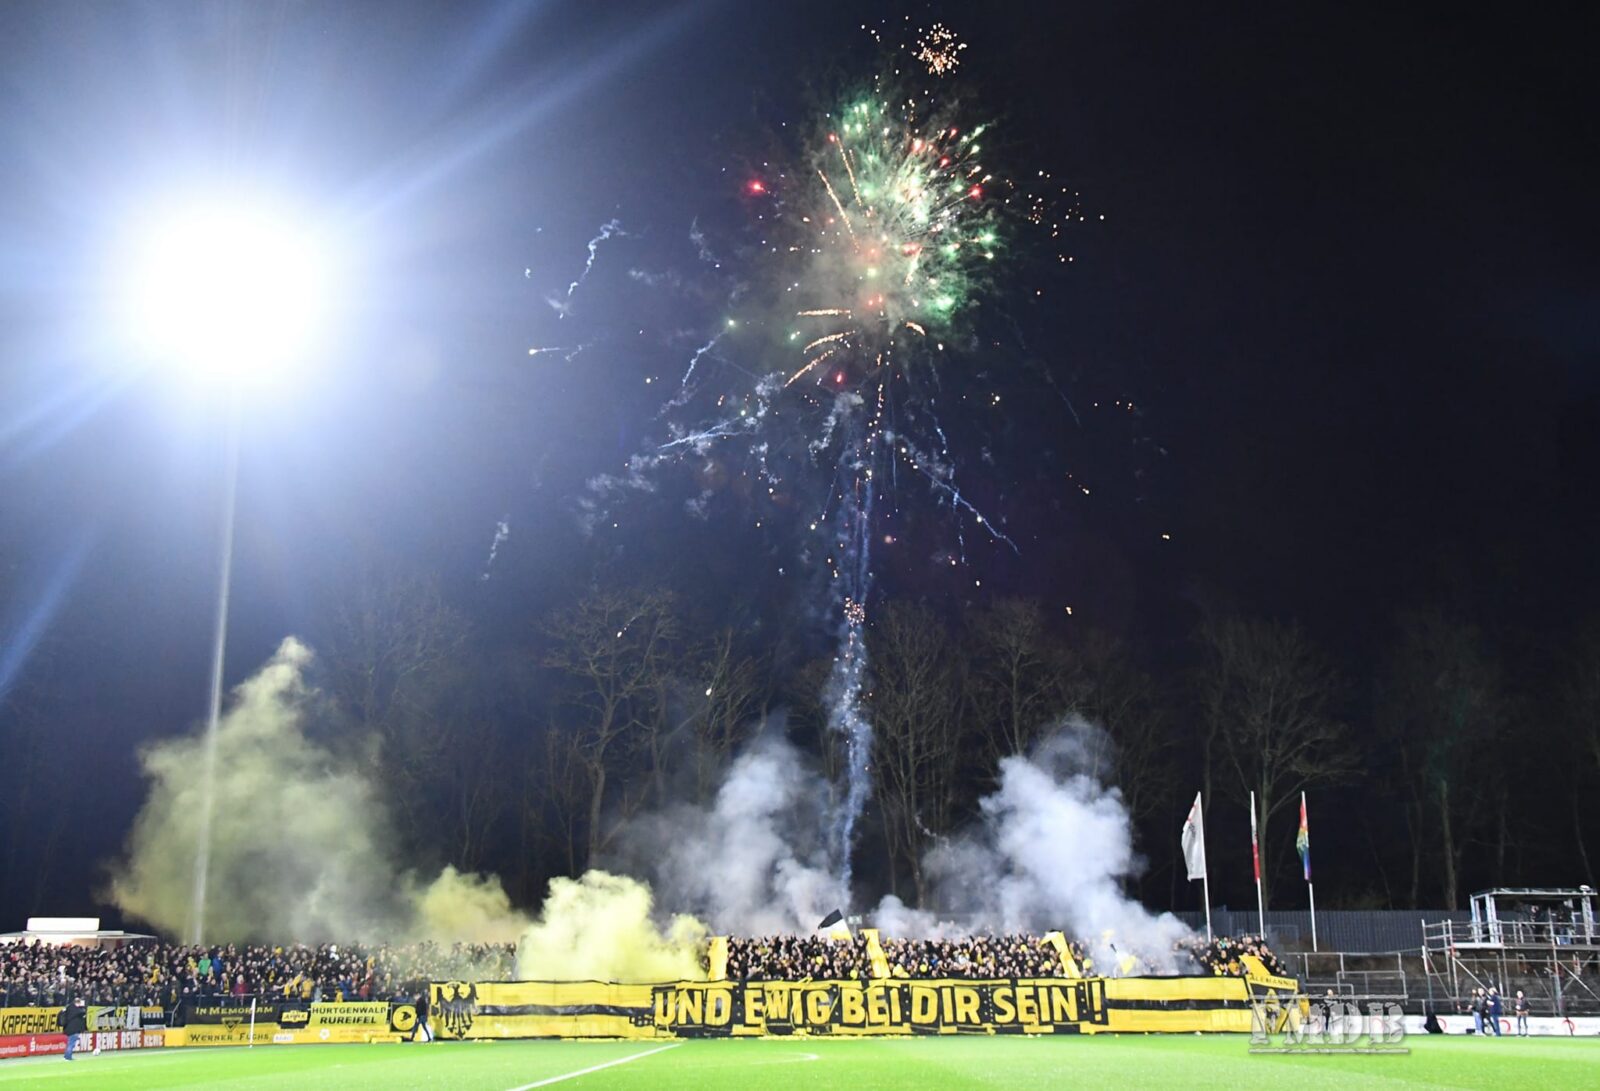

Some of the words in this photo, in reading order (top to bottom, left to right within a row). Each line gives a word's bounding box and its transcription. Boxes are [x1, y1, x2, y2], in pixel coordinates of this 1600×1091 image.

[209, 1006, 273, 1015] MEMORAM
[655, 988, 732, 1025] UND
[744, 988, 830, 1025] EWIG
[841, 986, 901, 1024] BEI
[911, 986, 981, 1024] DIR
[992, 986, 1079, 1025] SEIN
[1091, 981, 1102, 1021] !
[320, 1016, 377, 1025] RUREIFEL
[74, 1033, 93, 1051] EWE
[96, 1032, 118, 1050] REWE
[121, 1031, 142, 1048] REWE
